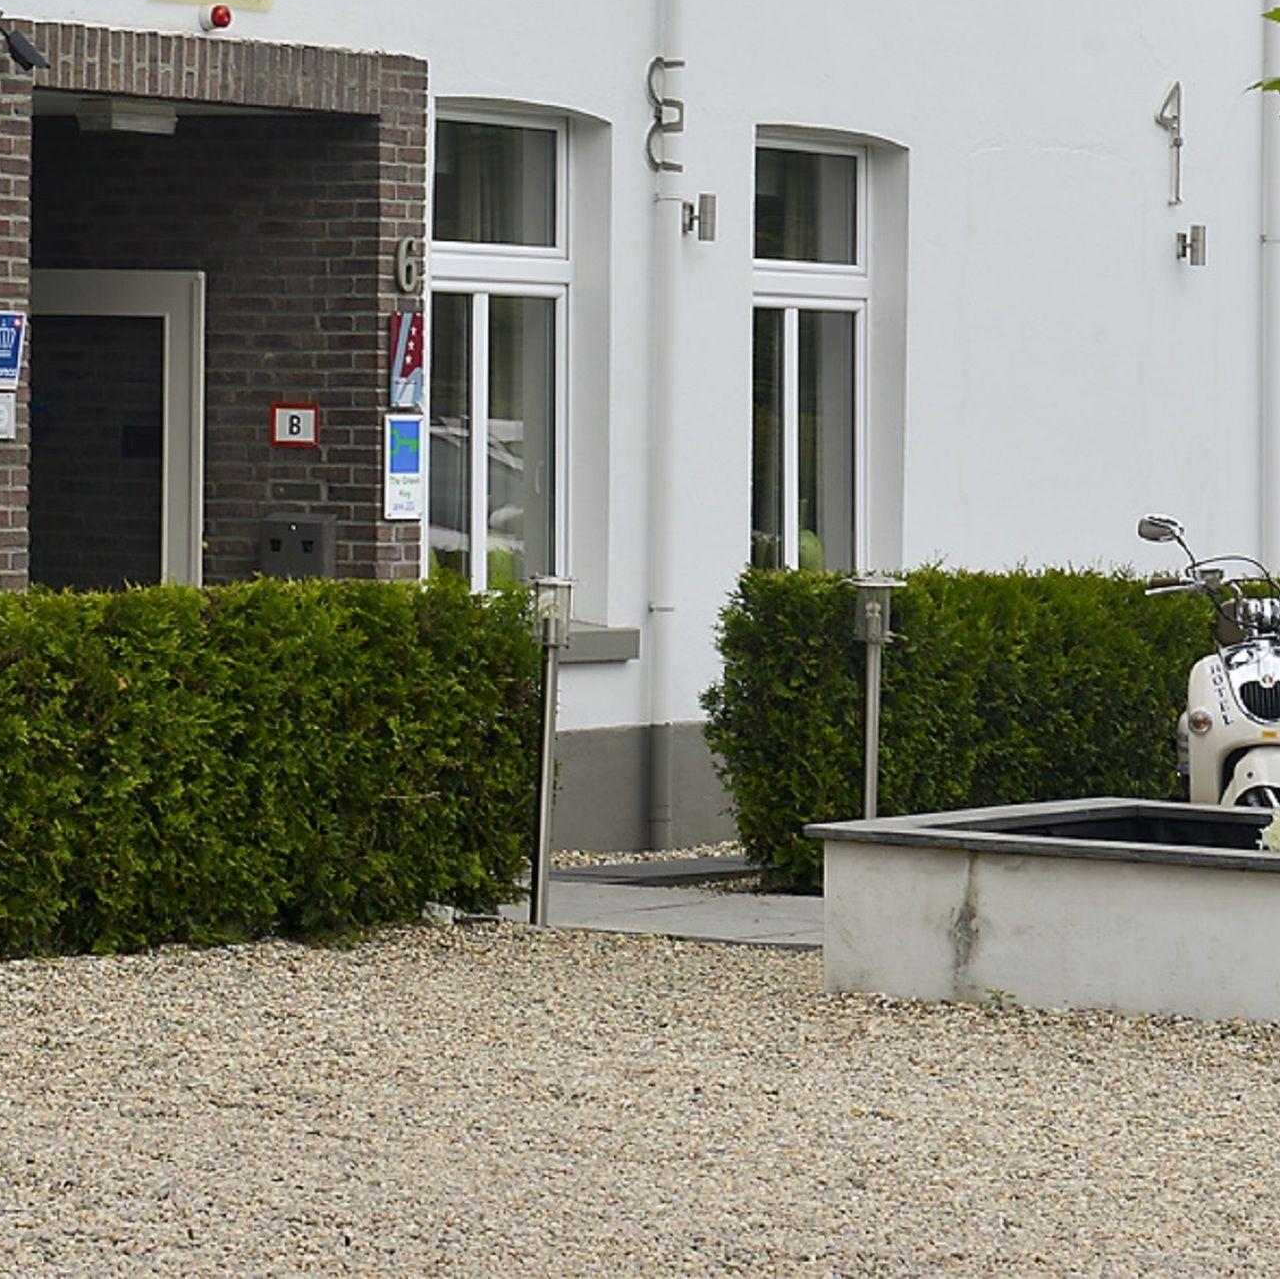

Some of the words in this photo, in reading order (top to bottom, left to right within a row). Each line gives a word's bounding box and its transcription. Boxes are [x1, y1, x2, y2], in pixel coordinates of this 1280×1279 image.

[395, 237, 418, 293] 6
[288, 416, 301, 435] B
[1210, 664, 1234, 725] HOTEL
